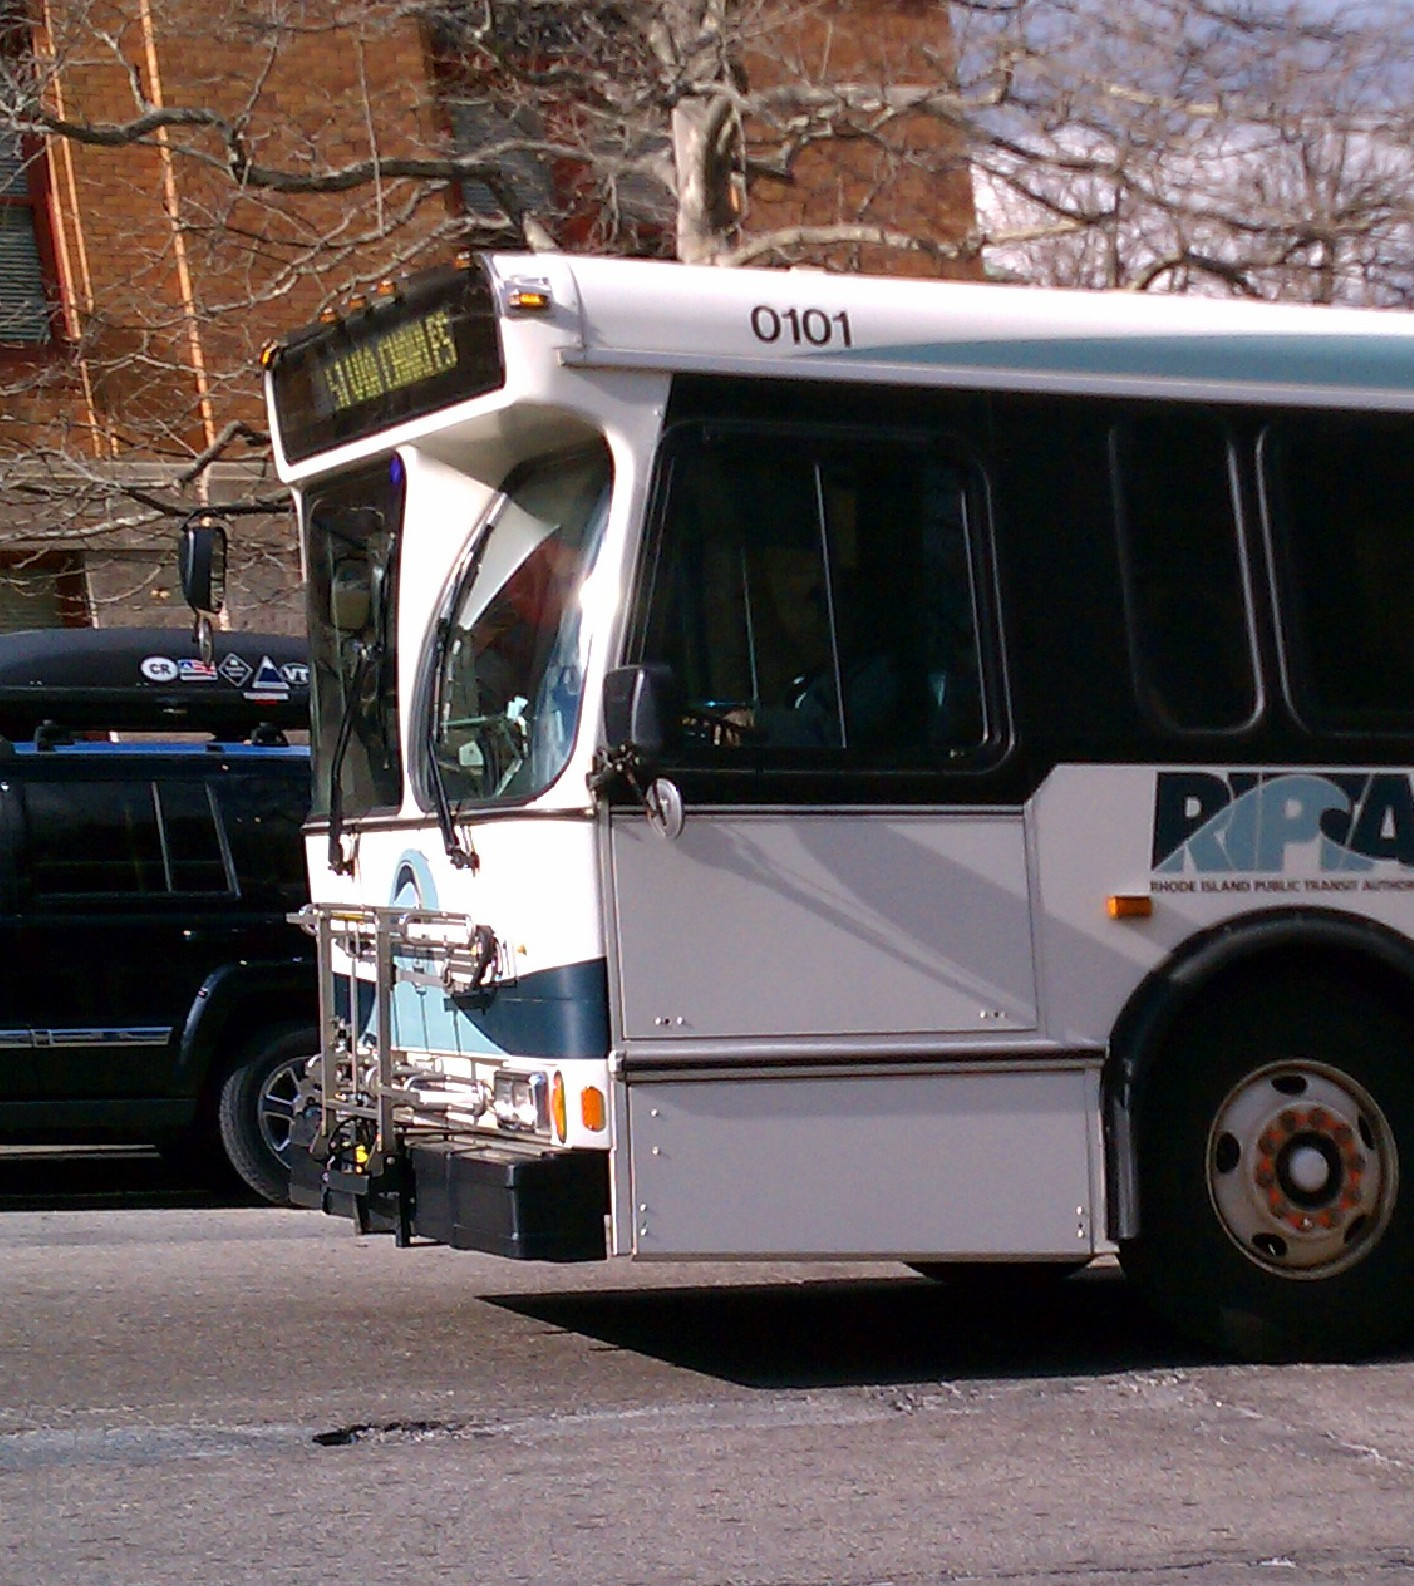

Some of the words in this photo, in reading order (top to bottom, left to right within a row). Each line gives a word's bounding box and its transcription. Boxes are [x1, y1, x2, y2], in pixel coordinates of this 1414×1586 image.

[751, 305, 851, 348] 0101
[1151, 880, 1194, 892] RHODE
[1201, 880, 1250, 892] ISLAND
[1253, 880, 1300, 892] PUBLIC
[1304, 880, 1357, 892] TRANSIT
